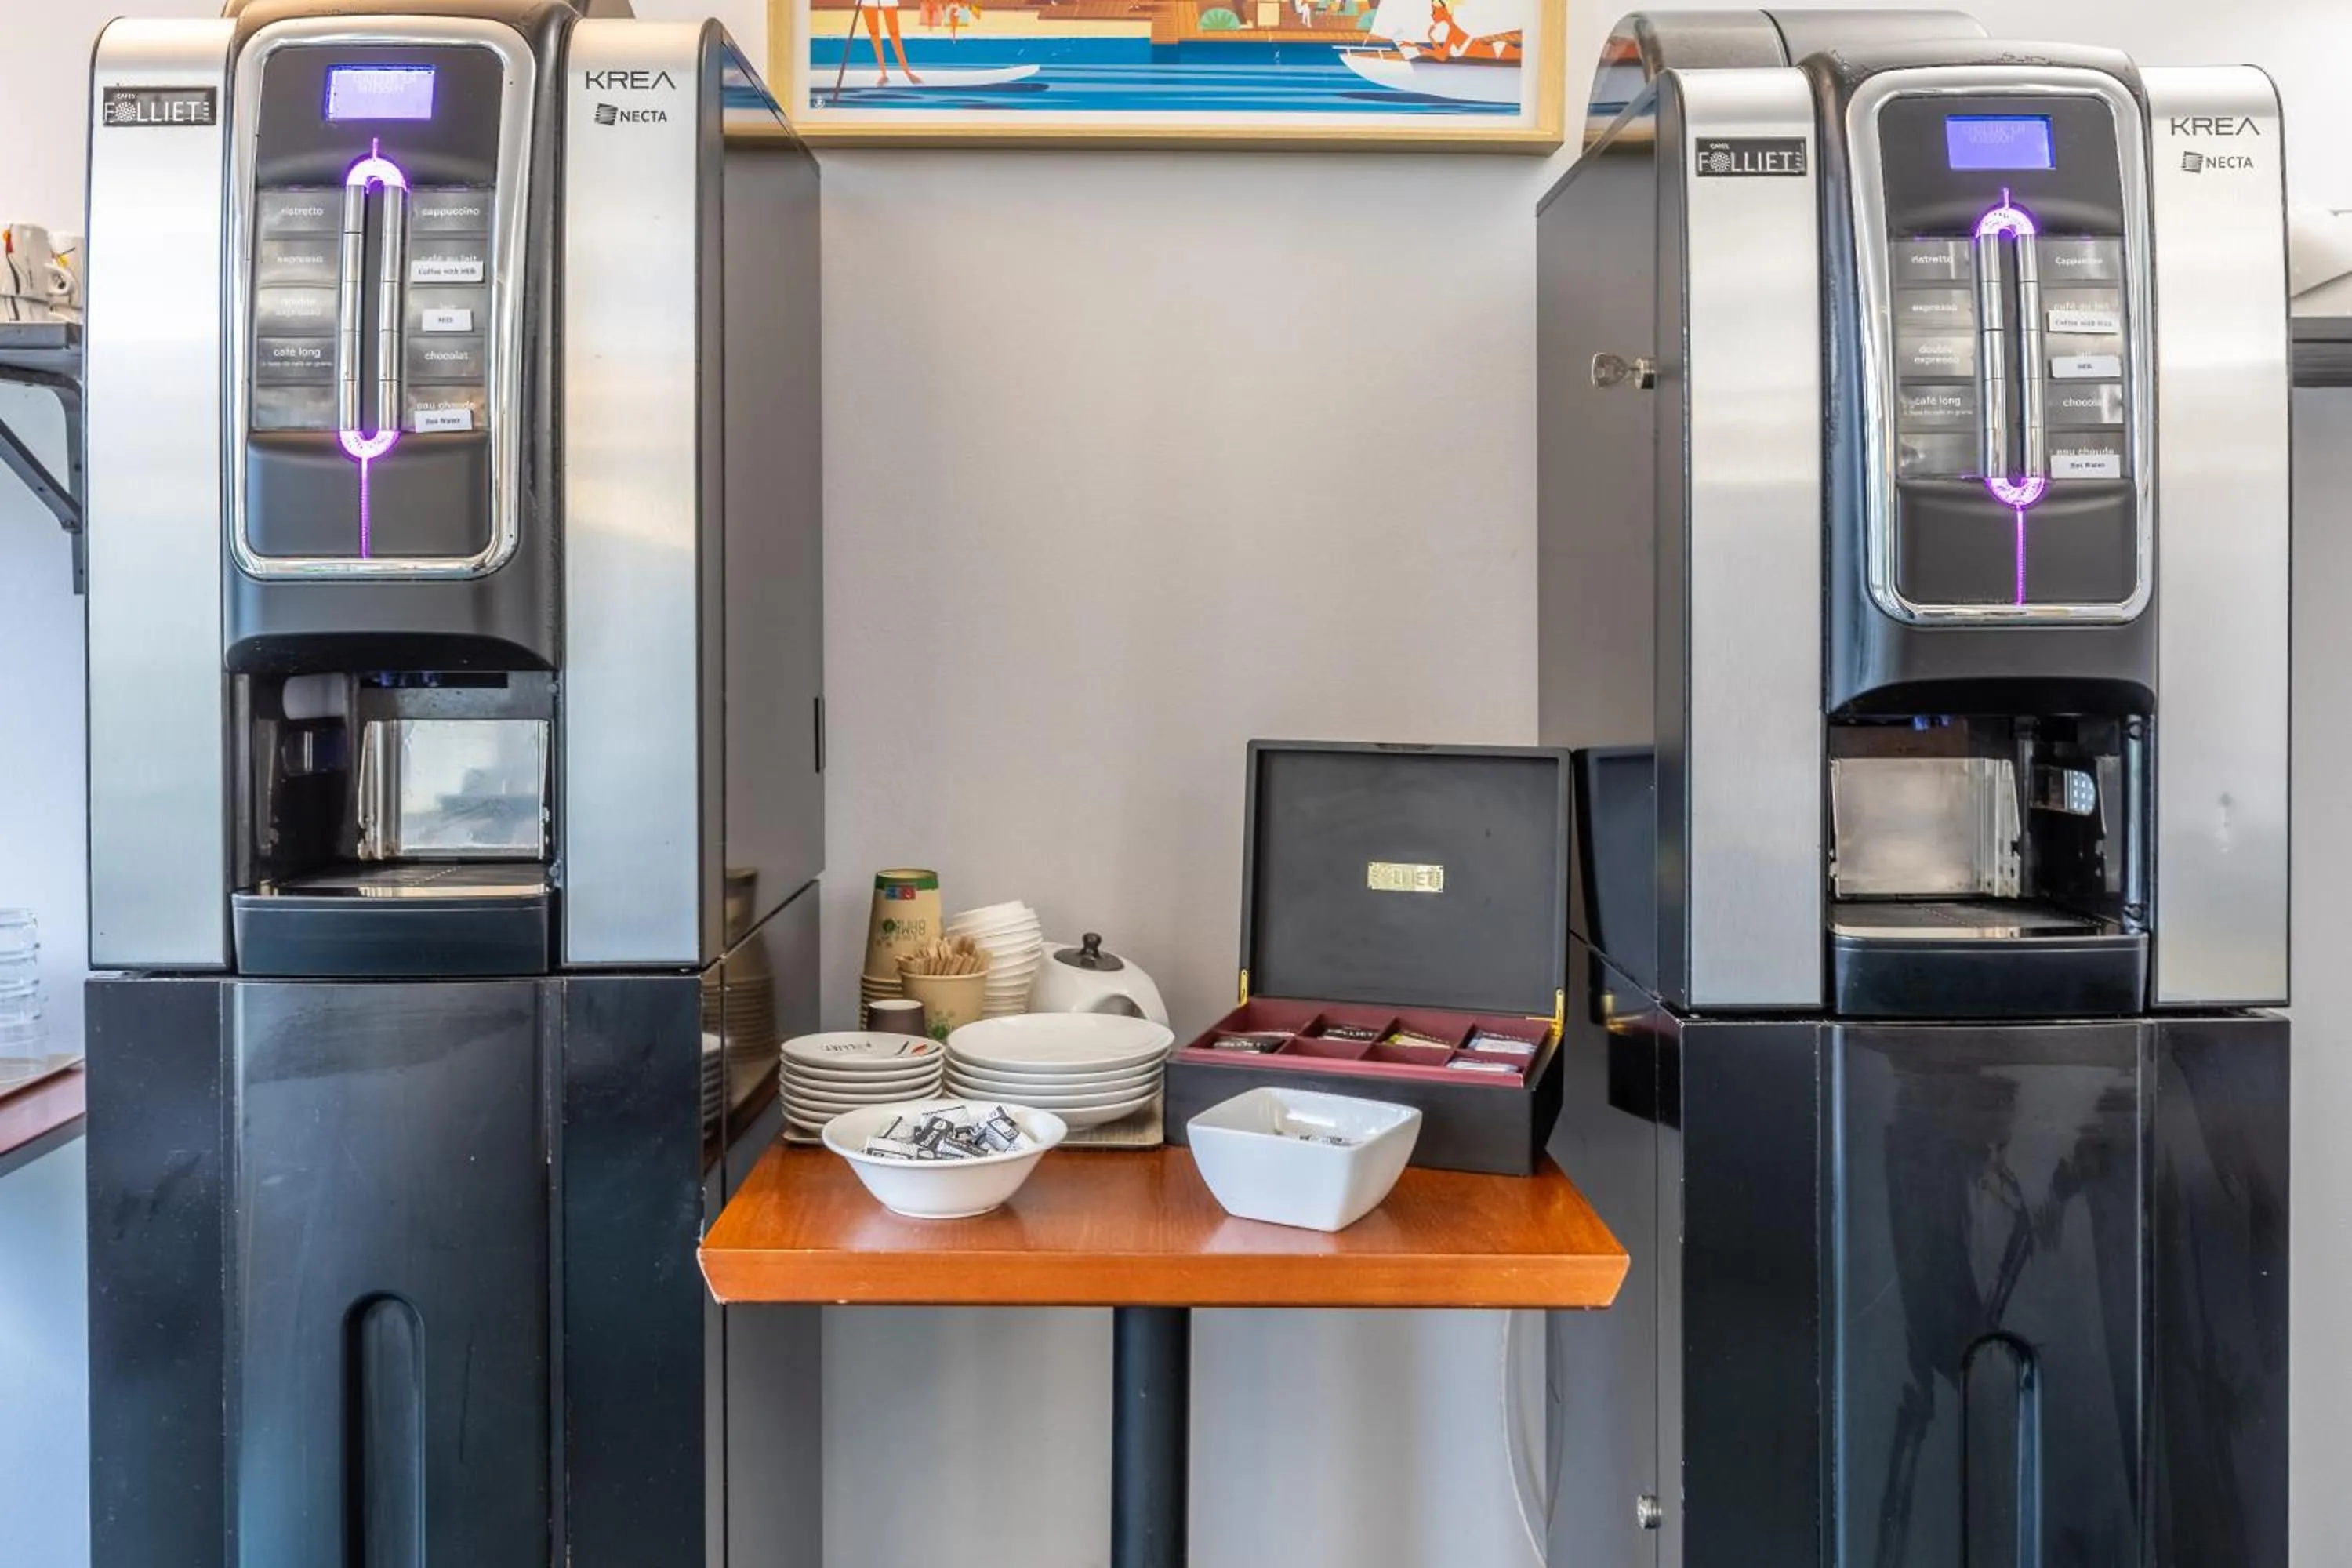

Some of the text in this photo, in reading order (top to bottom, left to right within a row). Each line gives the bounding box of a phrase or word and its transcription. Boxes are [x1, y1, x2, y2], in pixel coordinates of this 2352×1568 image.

[586, 71, 677, 89] KREA
[620, 111, 667, 122] NECTA
[2170, 117, 2260, 135] KREA
[2206, 156, 2253, 169] NECTA
[422, 207, 479, 218] cappuccino
[299, 347, 321, 358] long
[424, 350, 468, 360] chocolat
[1940, 395, 1961, 406] long
